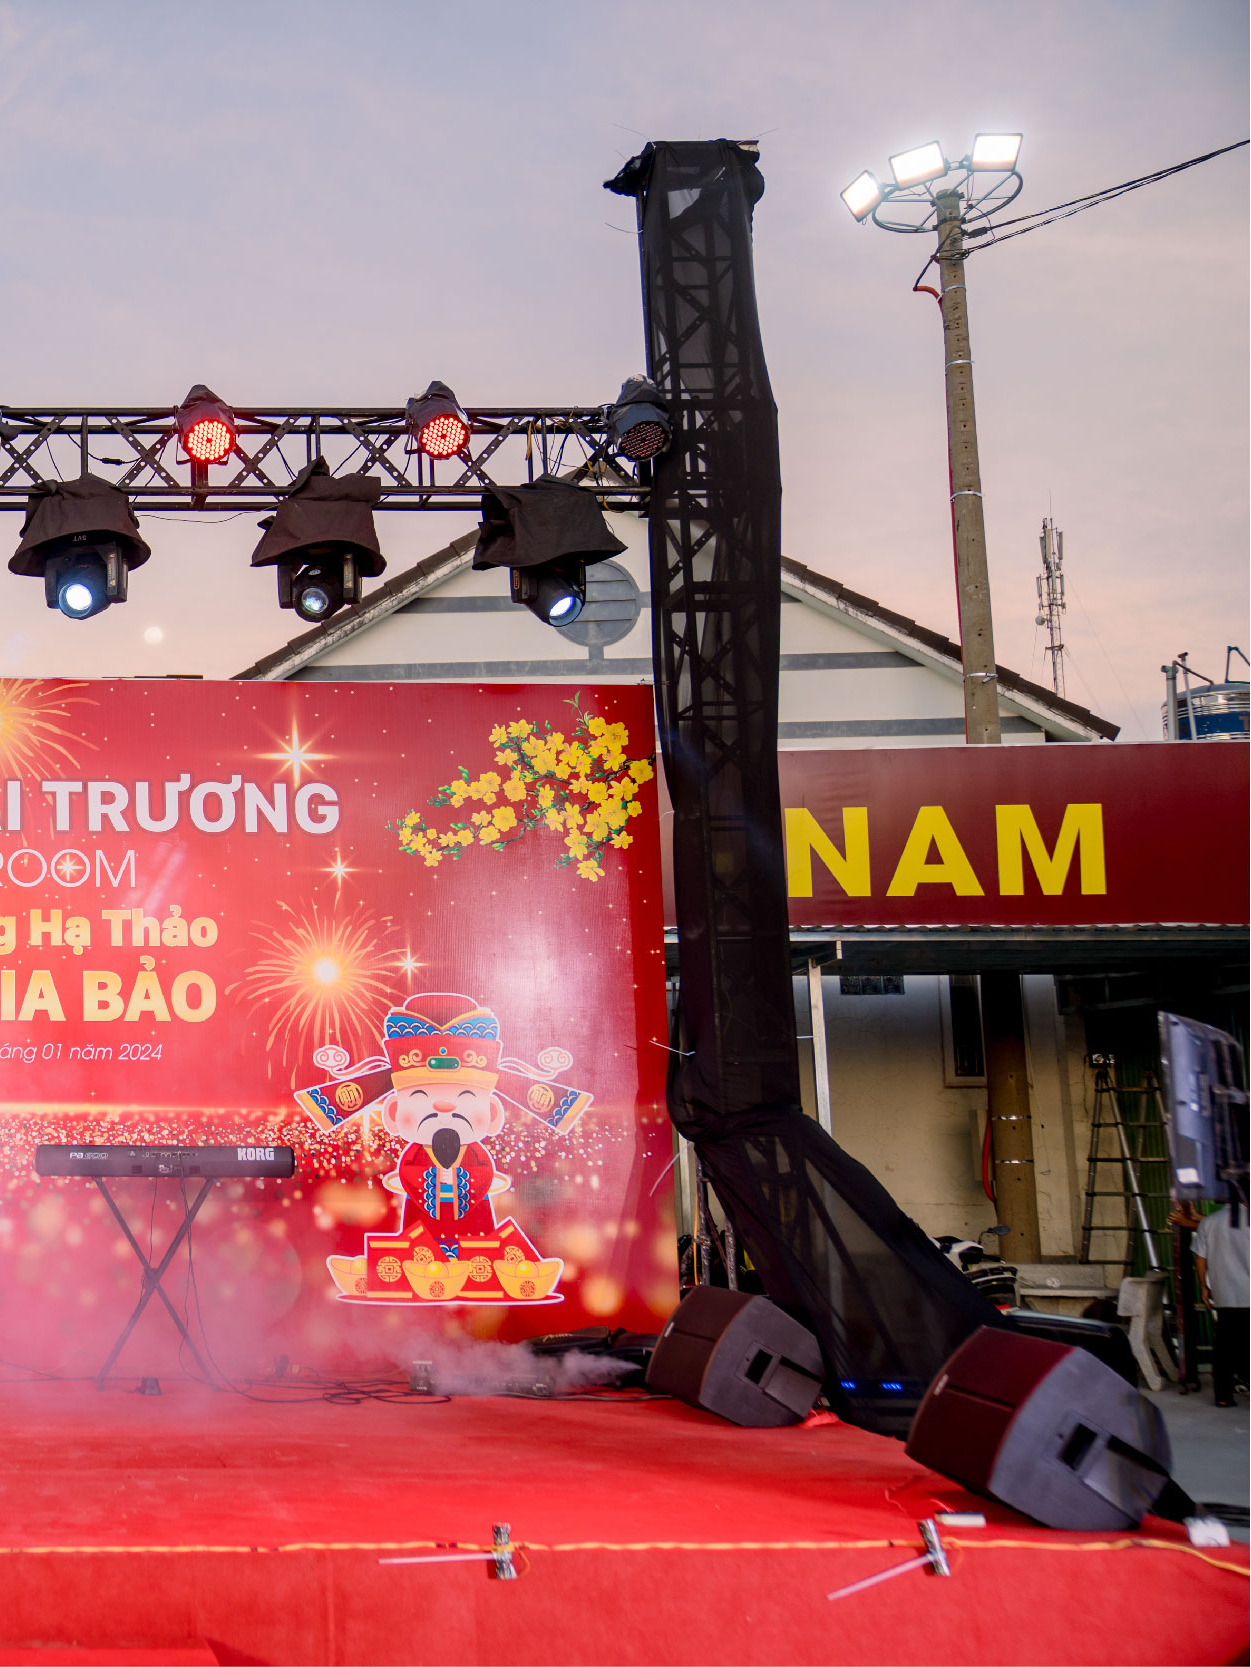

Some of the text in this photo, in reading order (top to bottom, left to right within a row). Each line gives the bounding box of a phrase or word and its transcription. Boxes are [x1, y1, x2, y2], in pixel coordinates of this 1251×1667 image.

[41, 772, 341, 834] TRƯƠNG
[784, 803, 1107, 898] NAM
[30, 909, 91, 955] Hạ
[101, 904, 219, 948] Thảo
[83, 955, 218, 1024] BẢO
[41, 1043, 63, 1060] 01
[69, 1043, 113, 1061] năm
[117, 1043, 164, 1061] 2024
[237, 1147, 275, 1161] KORG
